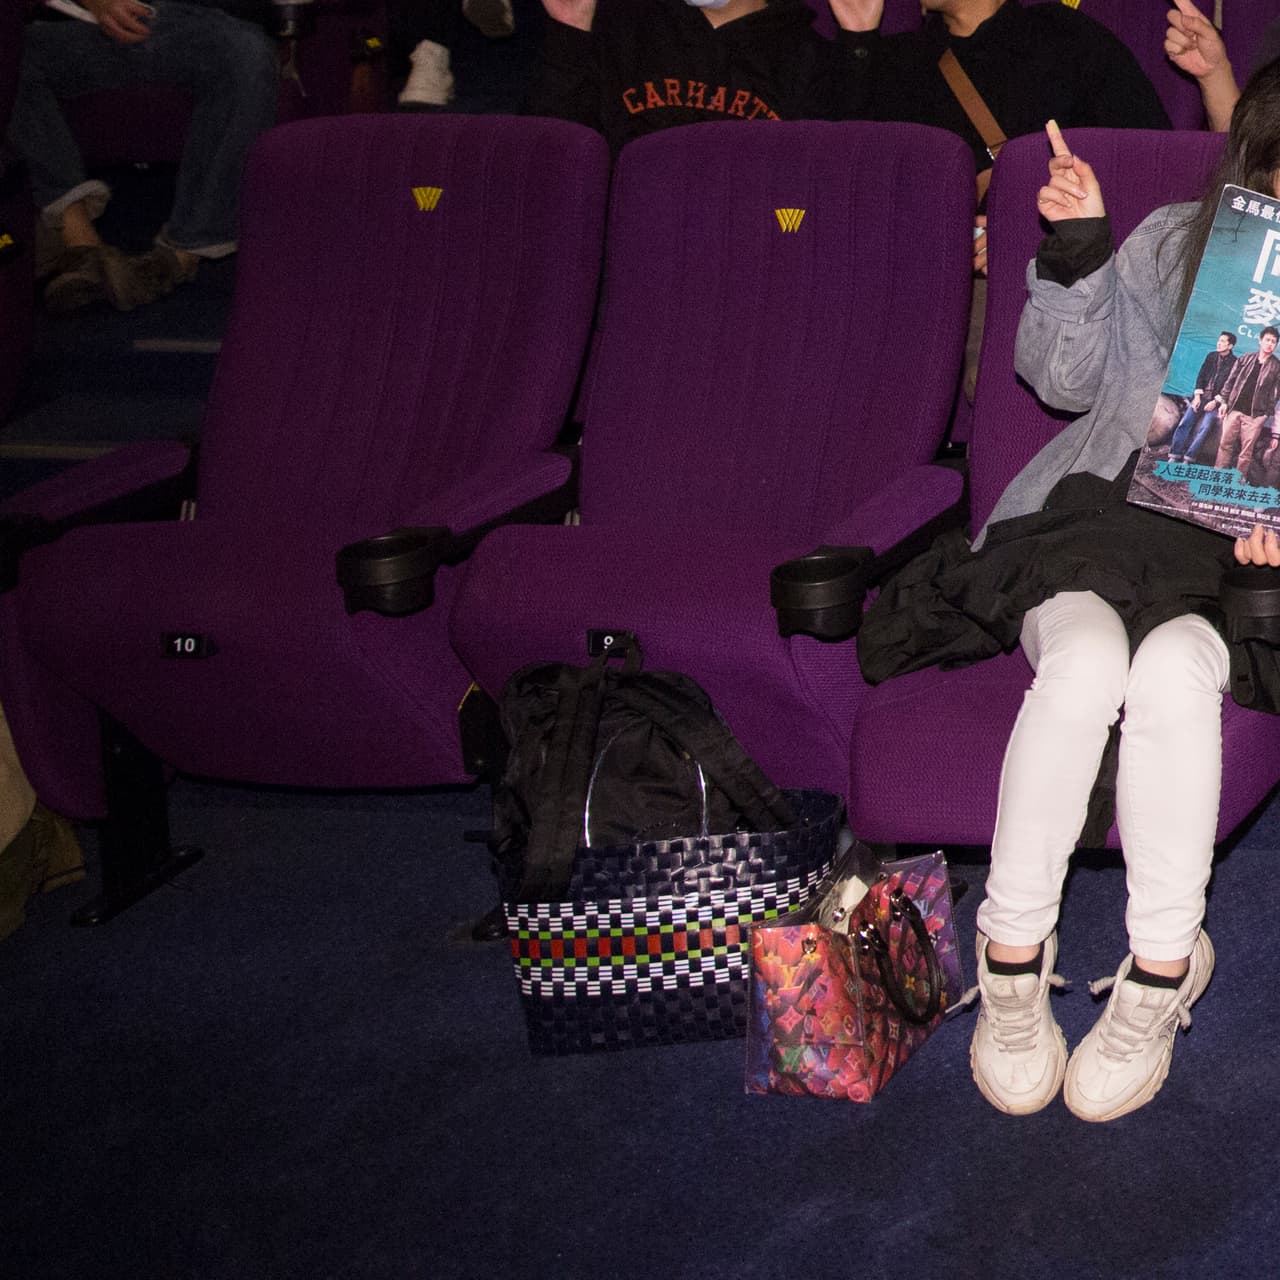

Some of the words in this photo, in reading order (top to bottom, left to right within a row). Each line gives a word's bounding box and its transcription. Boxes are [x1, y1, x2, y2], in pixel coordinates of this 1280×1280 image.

[1160, 464, 1235, 485] 人生起起落落
[1198, 483, 1271, 505] 同學來來去去
[173, 637, 196, 653] 10
